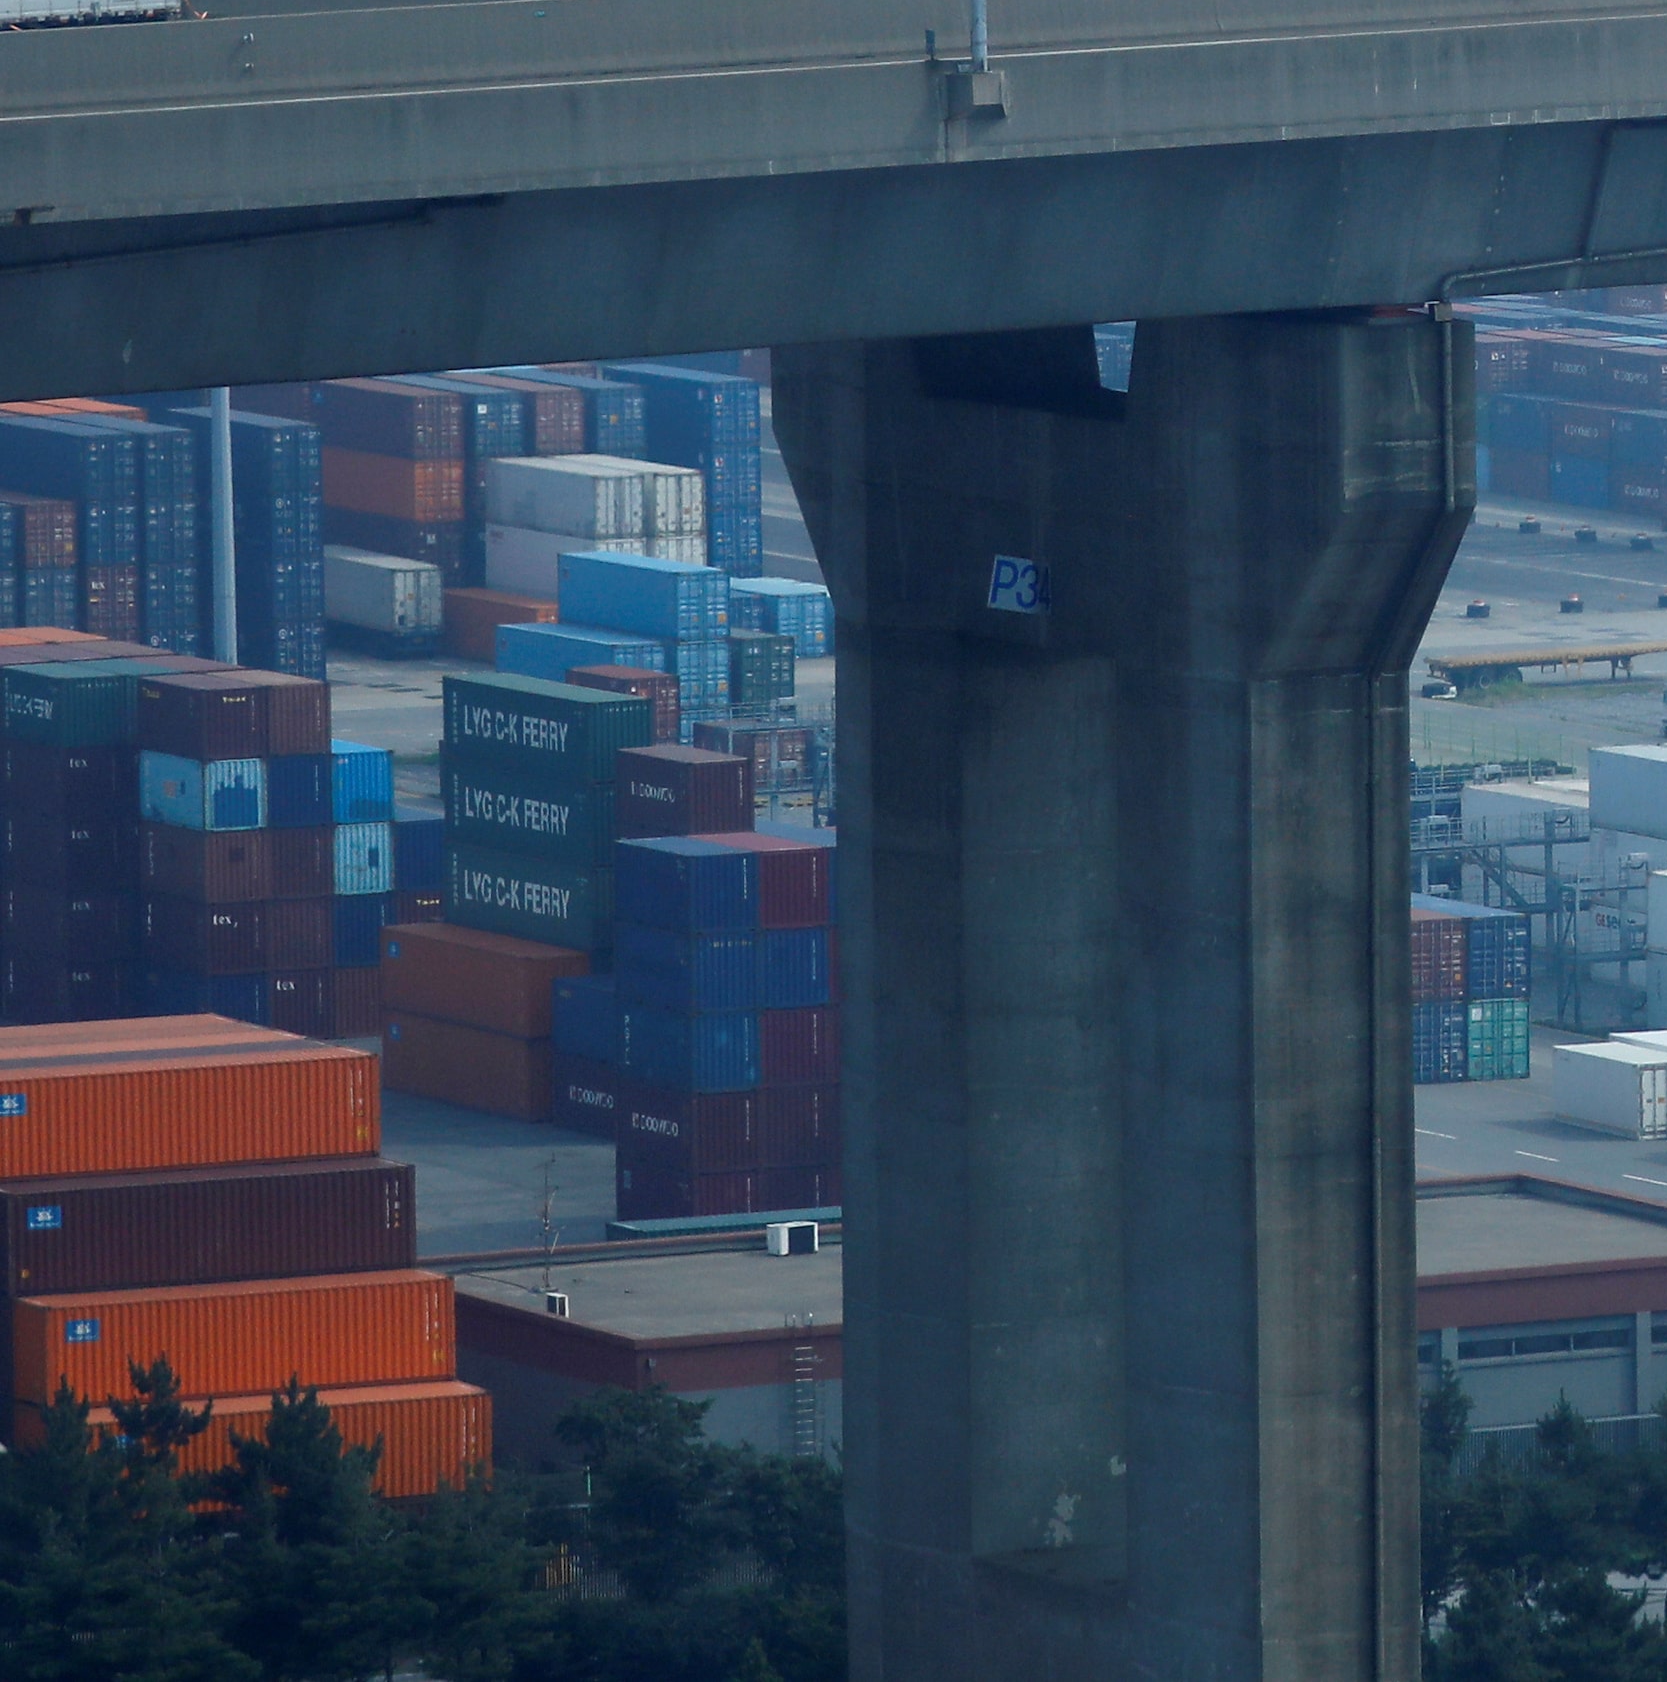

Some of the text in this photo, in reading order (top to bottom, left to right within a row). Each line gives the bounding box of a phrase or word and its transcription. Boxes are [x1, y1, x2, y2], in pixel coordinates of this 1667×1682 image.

[464, 704, 492, 739] LYG
[495, 711, 519, 744] C-K
[522, 715, 569, 753] FERRY
[465, 786, 570, 836] LYG C-K FERRY
[463, 868, 571, 920] LYG C-K FERRY
